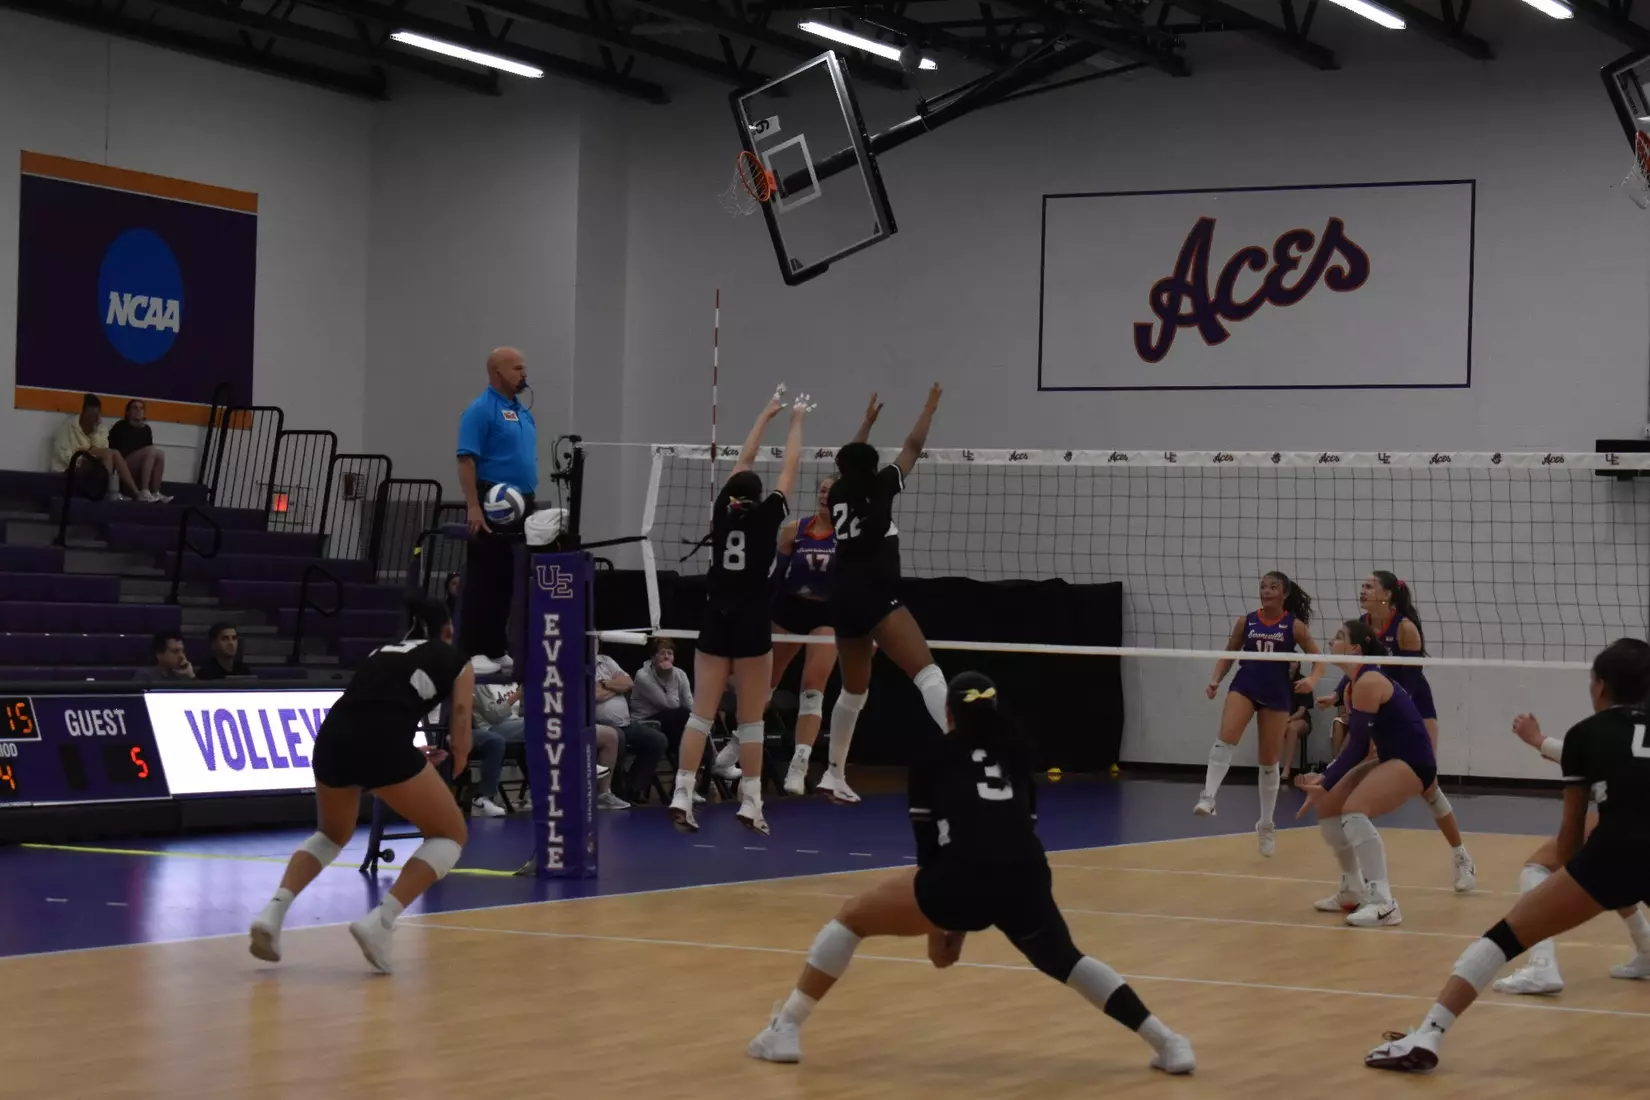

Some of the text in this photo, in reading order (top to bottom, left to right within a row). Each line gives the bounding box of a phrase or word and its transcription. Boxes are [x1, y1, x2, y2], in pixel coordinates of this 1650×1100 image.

[1134, 216, 1371, 364] Aces
[106, 290, 180, 334] NCAA
[722, 530, 746, 571] 8
[805, 554, 831, 572] 17
[536, 565, 574, 599] UE
[4, 702, 34, 735] 15
[64, 708, 128, 737] GUEST
[184, 707, 333, 771] VOLLEY
[541, 612, 566, 870] EVANSVILLE
[0, 763, 17, 791] 4
[129, 745, 150, 780] 5
[970, 747, 1015, 802] 3
